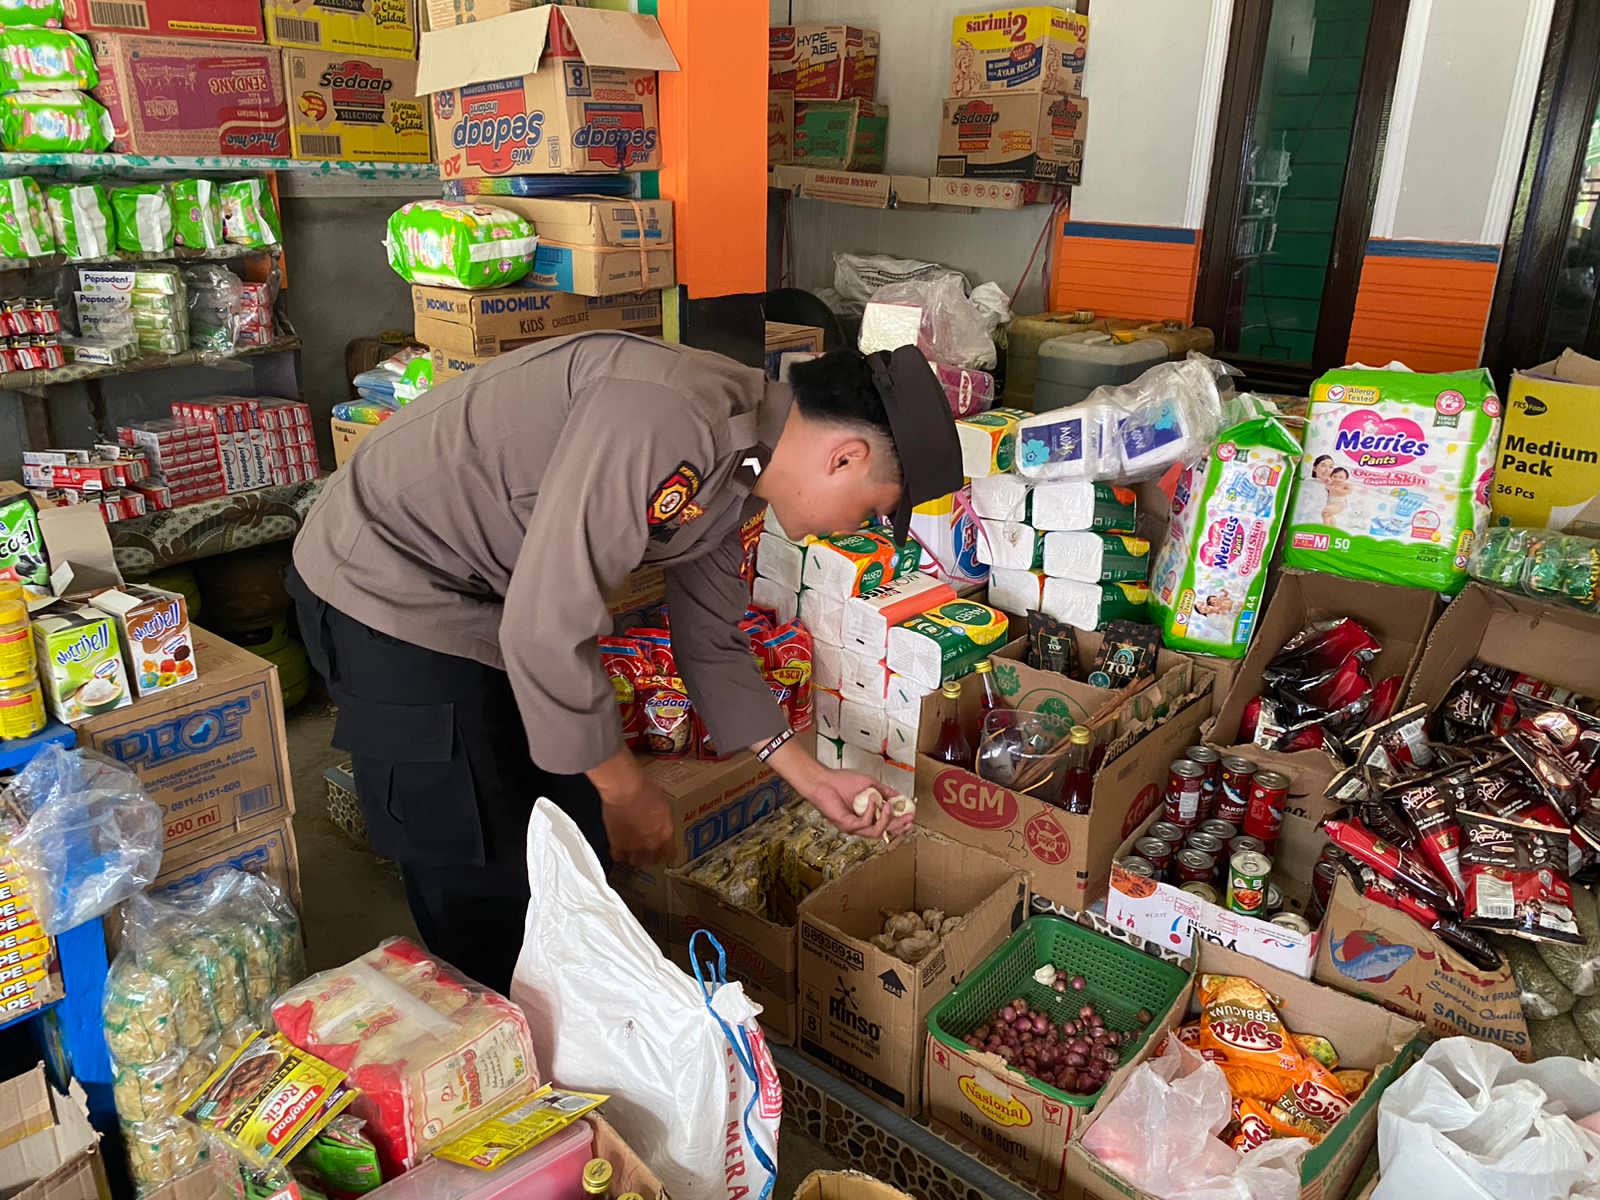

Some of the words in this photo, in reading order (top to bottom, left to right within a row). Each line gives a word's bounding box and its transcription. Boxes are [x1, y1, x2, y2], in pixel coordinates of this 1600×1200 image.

[966, 11, 1012, 33] sarimi
[1009, 14, 1028, 42] 2
[797, 31, 831, 48] HYPE
[811, 42, 838, 56] ABIS
[208, 75, 269, 95] RENDANG
[319, 72, 393, 94] Sedaap
[572, 68, 583, 87] 8
[634, 77, 655, 97] 20
[439, 90, 453, 107] 20
[469, 101, 498, 116] Instant
[339, 110, 382, 121] SELECTION
[951, 112, 1000, 125] Sedaap
[453, 110, 544, 152] Sedaap
[573, 125, 656, 150] Sedaap
[225, 131, 280, 152] Indomie
[444, 153, 462, 177] 20
[512, 146, 535, 166] Mie
[631, 149, 649, 163] Mie
[84, 273, 129, 284] Pepsodent
[481, 295, 552, 315] INDOMILK
[552, 311, 591, 329] CHOCOLATE
[1347, 394, 1376, 404] Tested
[1348, 387, 1377, 397] Allergy
[1513, 399, 1527, 410] FKS
[1528, 403, 1547, 413] Food
[1335, 430, 1430, 457] Merries
[1505, 434, 1599, 465] Medium
[222, 448, 235, 492] Pepsodent
[237, 446, 250, 490] Pepsodent
[253, 442, 267, 485] Pepsodent
[1358, 453, 1398, 467] Pants
[1501, 454, 1554, 478] Pack
[1496, 483, 1513, 496] 36
[1515, 487, 1536, 500] Pcs
[833, 534, 865, 549] PASEO
[1213, 515, 1240, 570] Merries
[1232, 533, 1244, 556] Pants
[1239, 544, 1257, 577] Good
[1248, 519, 1263, 547] Skin
[1313, 534, 1328, 550] M
[1334, 537, 1351, 551] 50
[862, 568, 883, 583] PASEO
[1246, 595, 1258, 609] 44
[134, 600, 182, 643] Nutrijell
[955, 607, 985, 622] PASEO
[57, 622, 109, 666] Nutrijell
[1047, 643, 1062, 652] TOP
[1106, 660, 1137, 676] TOP
[1039, 712, 1073, 729] ABC
[942, 778, 1005, 817] SGM
[166, 818, 193, 838] 600
[197, 810, 216, 827] ml
[884, 982, 902, 996] ATAS
[1433, 967, 1489, 1003] PREMIUM
[1491, 989, 1521, 1002] BRAND
[1426, 979, 1476, 1014] Superior
[807, 1015, 817, 1032] 8
[828, 996, 882, 1042] Rinso
[1209, 1004, 1280, 1023] SERBAGUNA
[1413, 1008, 1428, 1022] IN
[1432, 1001, 1527, 1046] SARDINES
[1208, 1020, 1284, 1050] Sajiku
[227, 1056, 298, 1135] RENDANG
[261, 1082, 301, 1122] Racik
[965, 1082, 1025, 1121] Nasional
[271, 1085, 319, 1140] Indofood
[960, 1111, 973, 1129] ISI
[995, 1132, 1029, 1162] BOTOL
